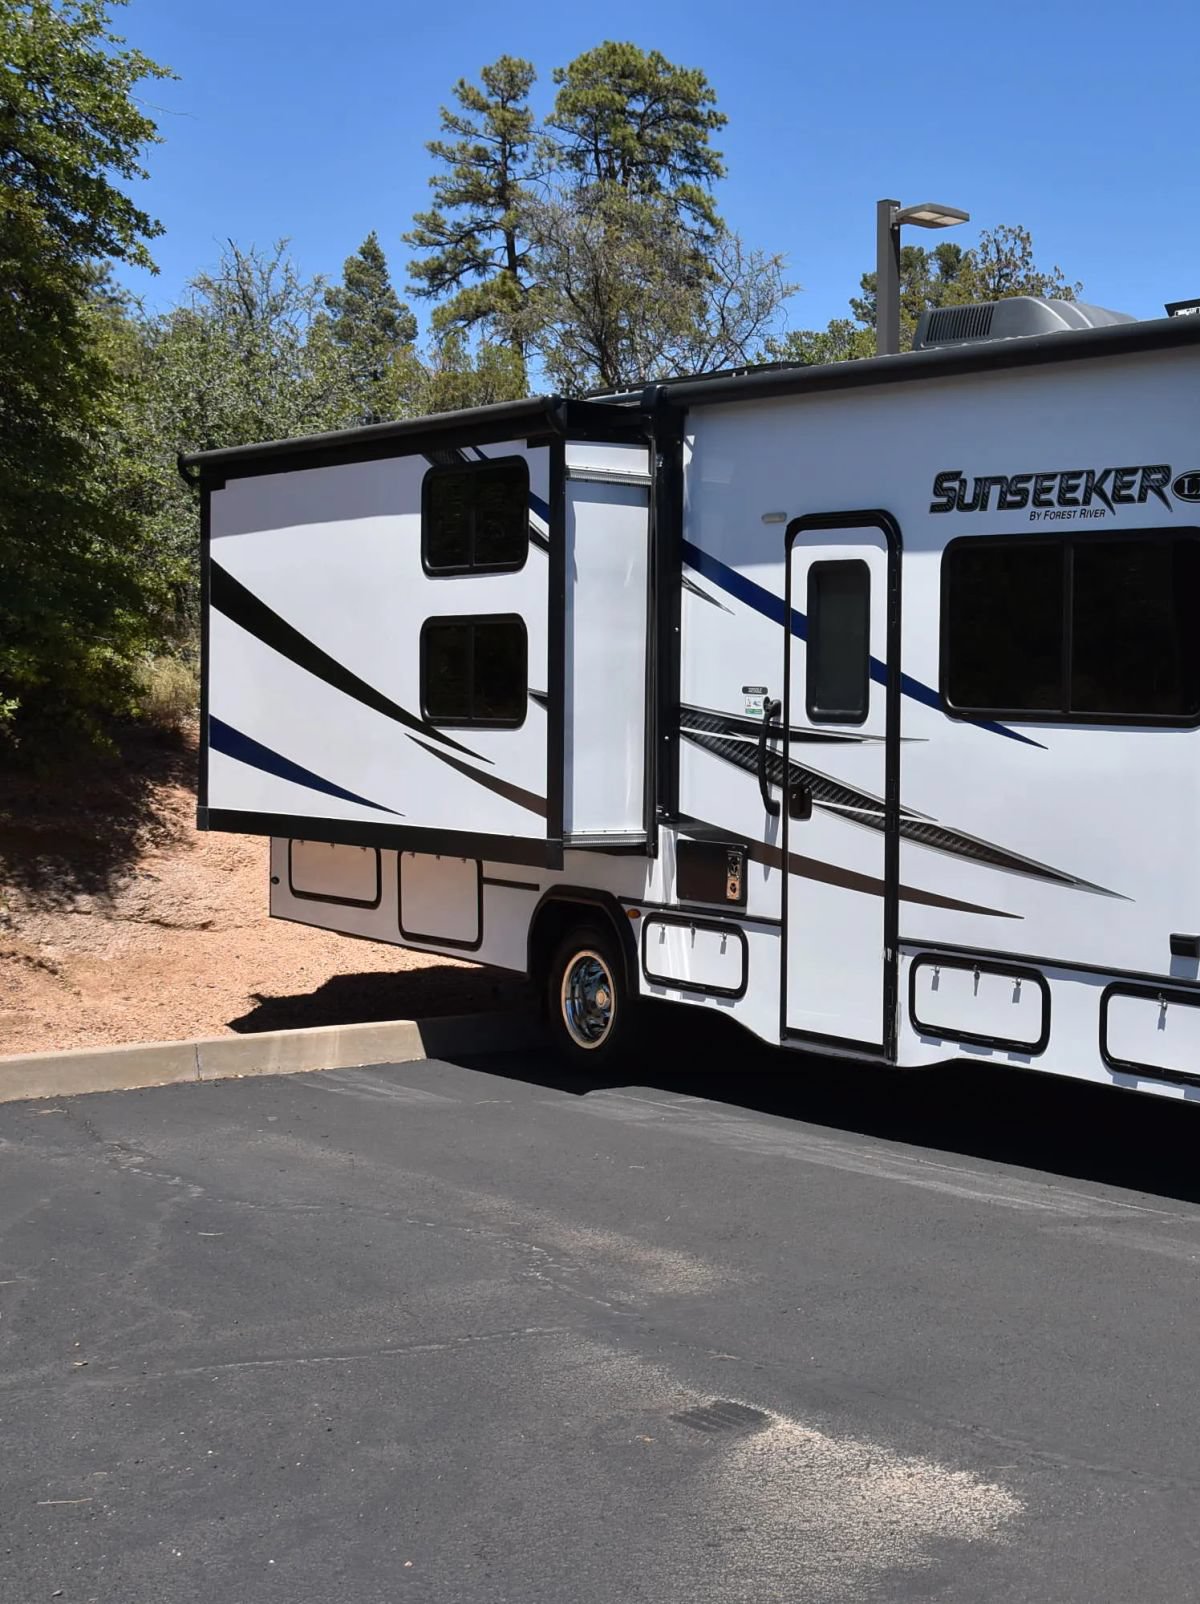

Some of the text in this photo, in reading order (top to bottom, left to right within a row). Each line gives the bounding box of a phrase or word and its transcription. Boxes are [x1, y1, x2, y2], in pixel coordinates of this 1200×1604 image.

[929, 464, 1173, 516] SUNSEEKER
[1043, 509, 1078, 521] FOREST
[1079, 508, 1106, 519] RIVER
